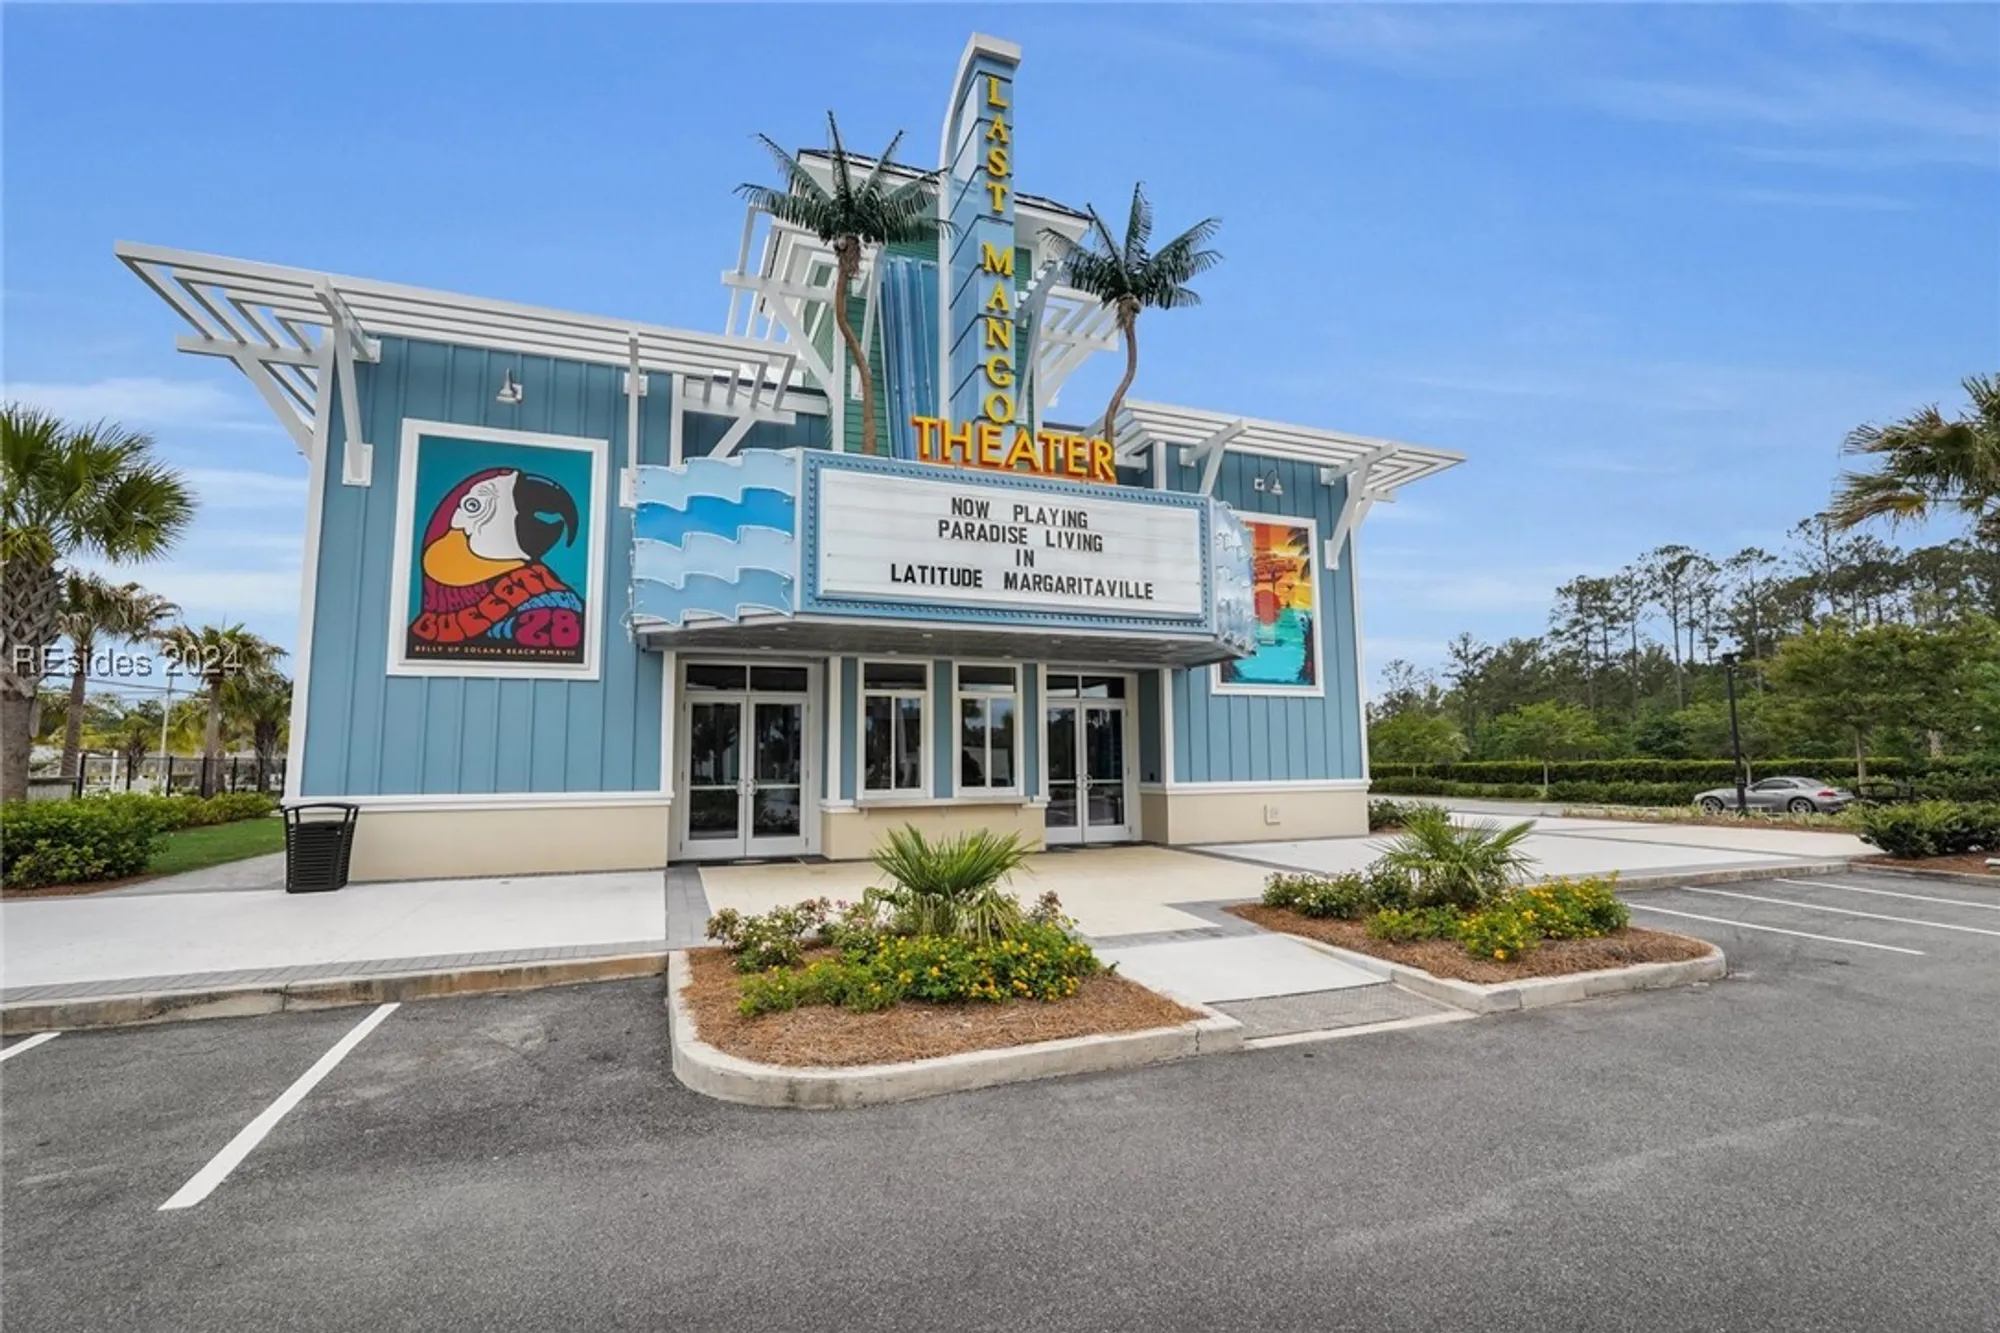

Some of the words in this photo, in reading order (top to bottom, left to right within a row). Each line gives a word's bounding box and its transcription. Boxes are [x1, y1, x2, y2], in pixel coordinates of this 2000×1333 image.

[986, 75, 1008, 214] LAST
[983, 242, 1015, 425] MANGO
[911, 415, 1117, 482] THEATER
[951, 497, 990, 519] NOW
[1013, 504, 1088, 529] PLAYING
[938, 519, 1028, 545] PARADISE
[1046, 531, 1103, 552] LIVING
[1016, 549, 1034, 568] IN
[890, 563, 983, 588] LATITUDE
[1004, 571, 1154, 600] MARGARITAVILLE
[515, 607, 580, 647] 28
